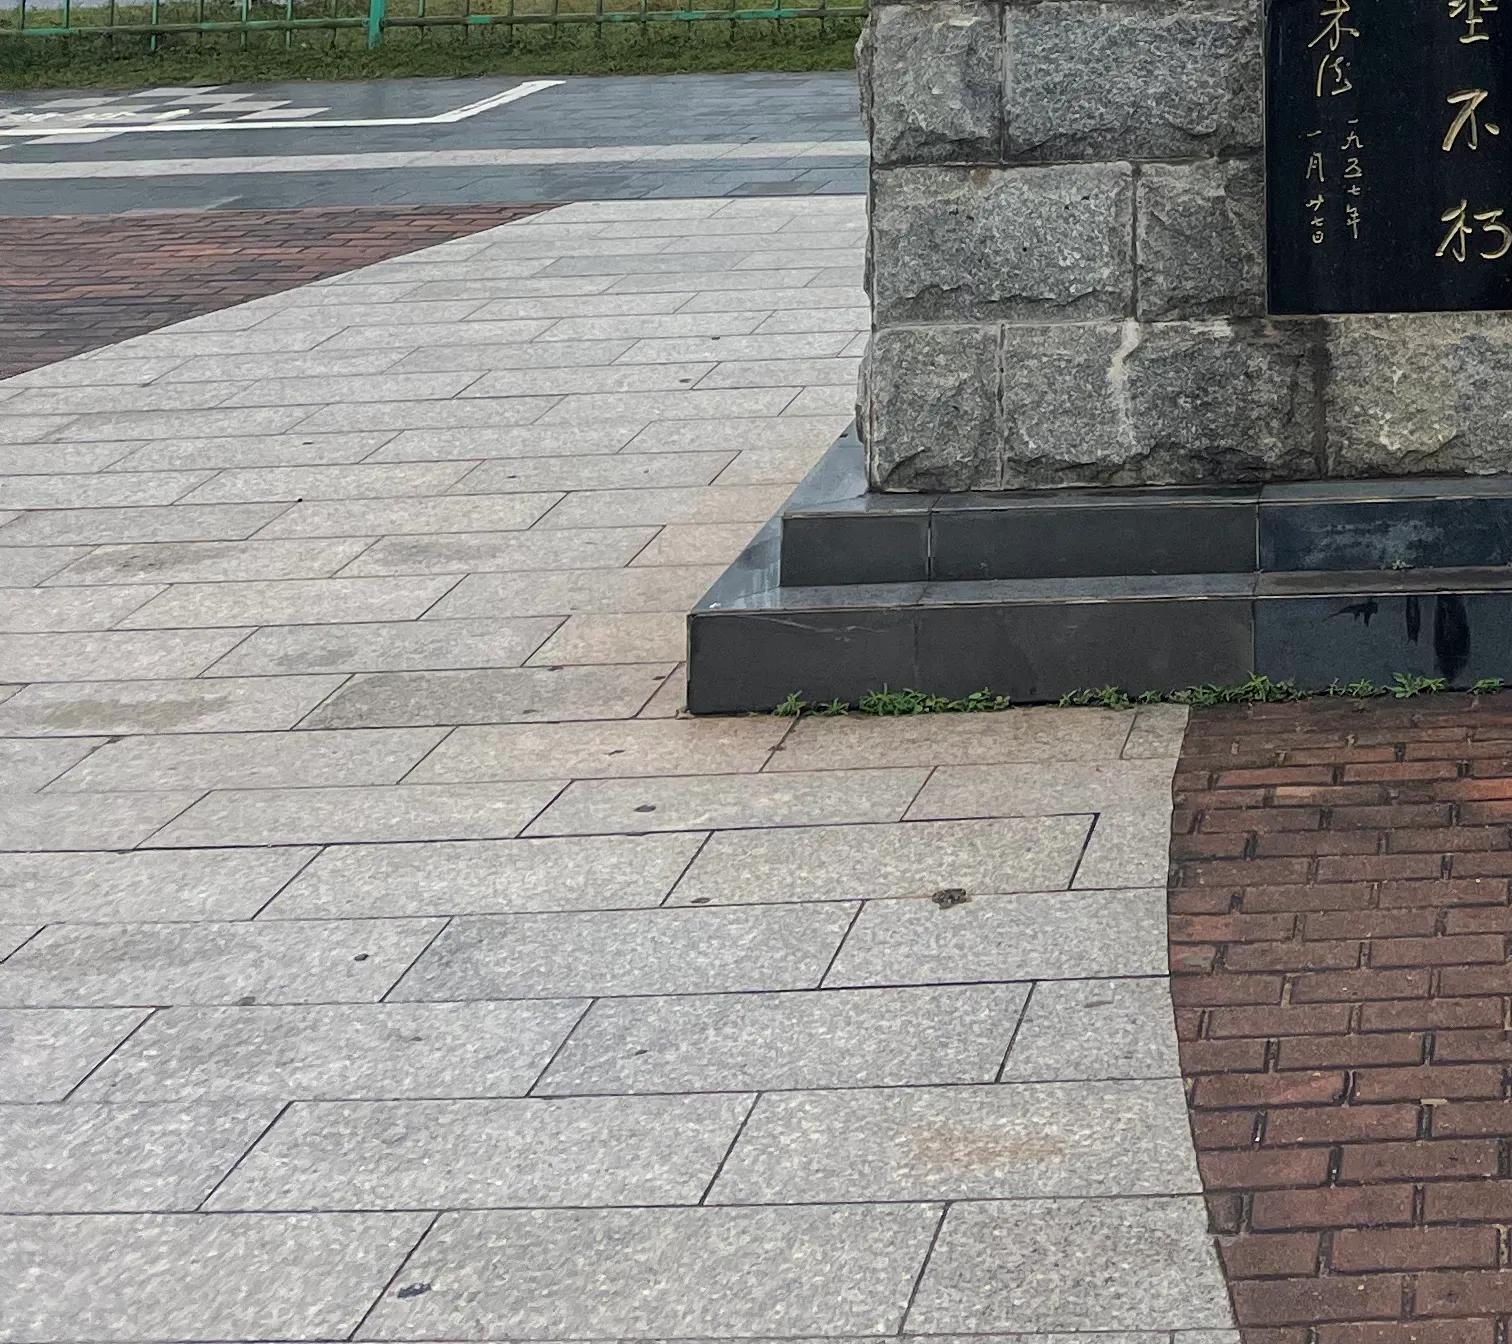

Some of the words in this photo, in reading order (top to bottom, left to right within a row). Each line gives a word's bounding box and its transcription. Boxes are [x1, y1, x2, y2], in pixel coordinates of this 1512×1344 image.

[1340, 118, 1364, 240] 一九五七年
